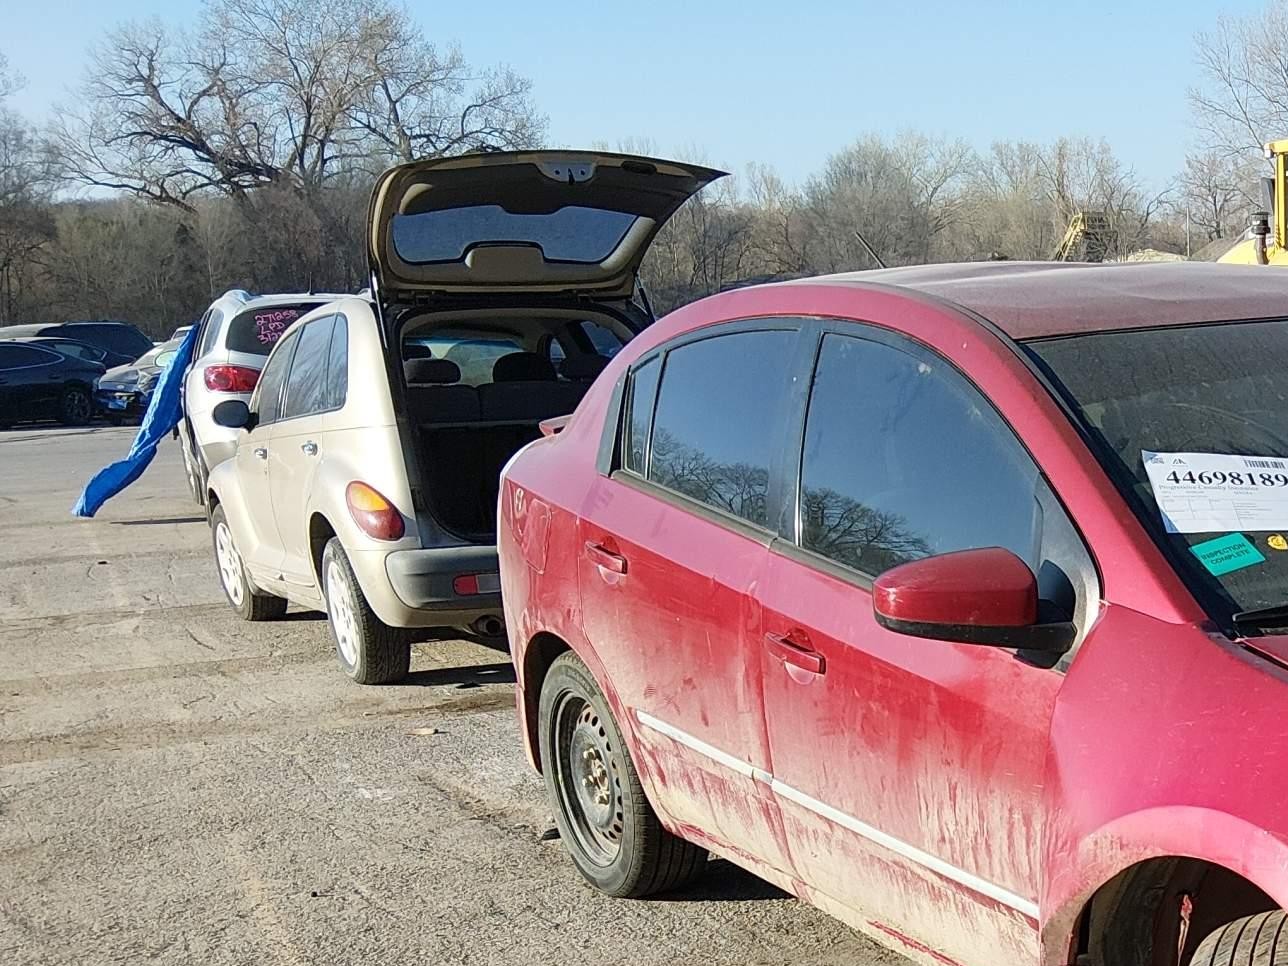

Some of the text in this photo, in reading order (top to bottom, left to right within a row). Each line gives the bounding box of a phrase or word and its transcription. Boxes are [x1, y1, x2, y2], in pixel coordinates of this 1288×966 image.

[1166, 468, 1288, 488] 44698189
[1201, 542, 1246, 560] INSPECTION
[1211, 549, 1250, 565] COMPLETE
